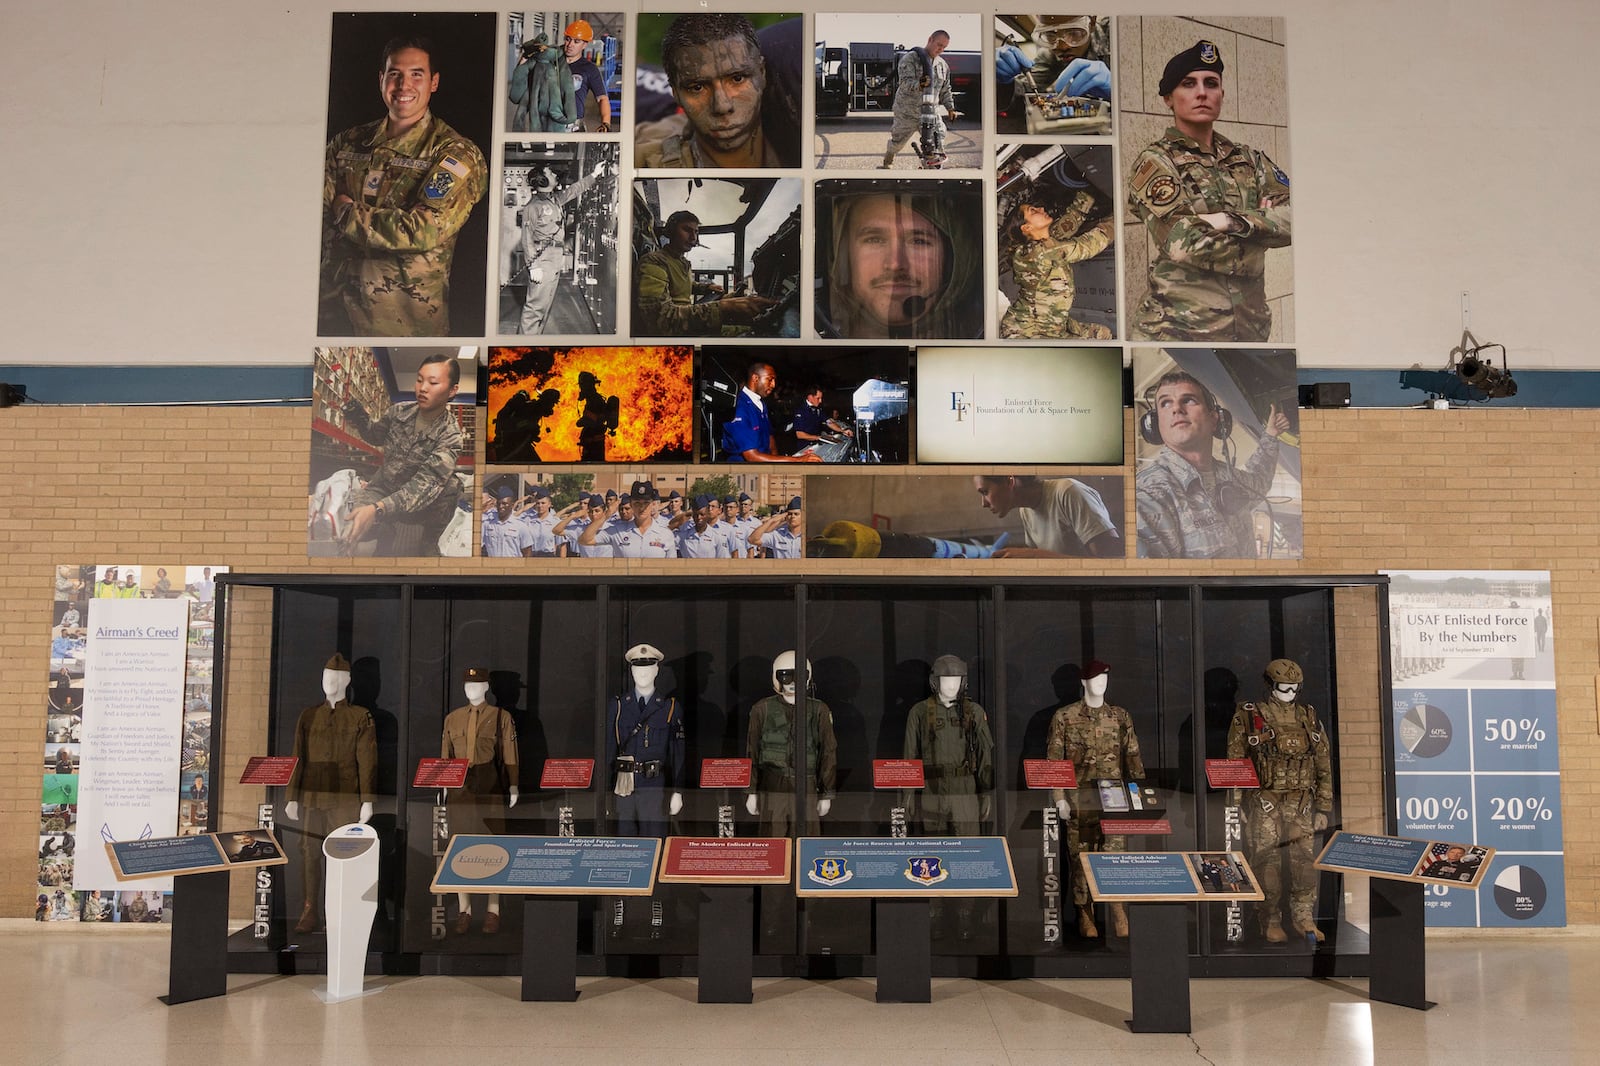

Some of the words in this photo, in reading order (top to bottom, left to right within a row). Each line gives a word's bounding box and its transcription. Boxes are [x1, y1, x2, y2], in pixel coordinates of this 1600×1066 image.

[1048, 407, 1068, 415] Space
[1407, 614, 1440, 626] USAF
[1445, 614, 1491, 626] Enlisted
[1495, 614, 1528, 626] Force
[96, 626, 143, 637] Airman's
[146, 626, 179, 637] Creed
[1419, 632, 1434, 645] By
[1439, 632, 1457, 642] the
[1462, 632, 1517, 642] Numbers
[1484, 718, 1546, 742] 50%
[1490, 797, 1552, 821] 20%
[1043, 807, 1059, 941] ENLISTED
